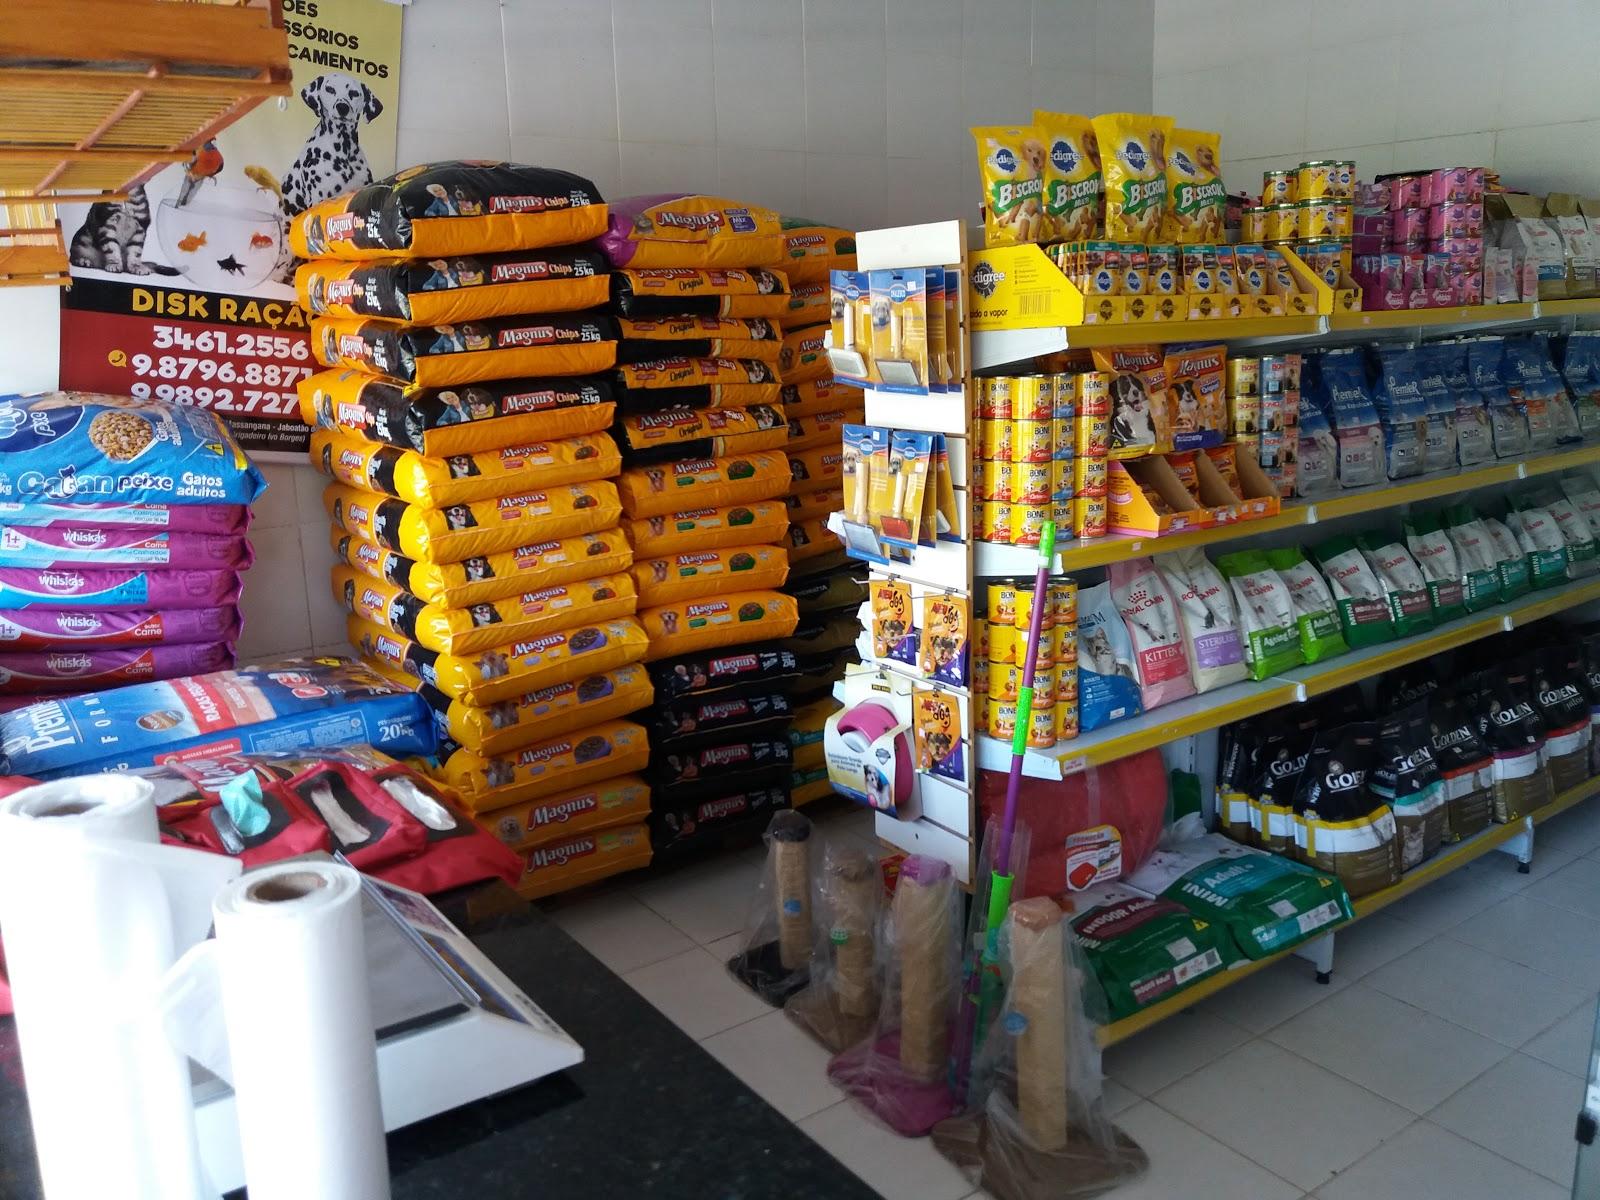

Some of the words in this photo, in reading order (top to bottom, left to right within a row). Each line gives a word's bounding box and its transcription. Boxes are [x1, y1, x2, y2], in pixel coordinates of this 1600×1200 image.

[288, 44, 388, 79] CAMENTOS
[490, 197, 542, 213] Magnus
[544, 196, 569, 208] Chips
[570, 198, 590, 208] 25kg
[327, 216, 352, 240] Magnus
[657, 212, 719, 229] Magnus
[789, 234, 824, 248] Magnus
[492, 263, 546, 281] Magnus
[549, 263, 573, 275] Chips
[574, 266, 595, 277] 25kg
[328, 281, 352, 305] Magnus
[679, 277, 704, 292] Original
[132, 288, 209, 319] DISK
[219, 297, 311, 330] RAÇÃ
[152, 325, 309, 361] 3461.2556
[498, 328, 553, 347] Magnus
[556, 329, 580, 340] Chips
[581, 332, 600, 343] 25kg
[340, 335, 364, 360] Magnus
[1113, 352, 1158, 372] Magnus
[1174, 357, 1219, 378] Magnus
[991, 383, 1010, 392] BONE
[503, 394, 554, 414] Magnus
[556, 393, 580, 403] Chips
[339, 403, 366, 428] Magnus
[639, 410, 695, 430] Magnus
[229, 420, 271, 431] assangana
[277, 423, 309, 433] Jaboatão
[679, 422, 703, 438] Original
[233, 432, 266, 440] rigadeiro
[501, 444, 547, 459] Magnus
[674, 459, 716, 475] Magnus
[117, 472, 174, 493] peixe
[182, 471, 223, 487] Gatos
[176, 485, 226, 498] adultos
[497, 493, 546, 510] Magnus
[1027, 510, 1045, 519] BONE
[4, 533, 21, 545] 1+
[63, 531, 106, 544] whiskas
[515, 541, 561, 559] Magnus
[678, 551, 719, 567] Magnus
[39, 574, 84, 586] whiskas
[521, 586, 567, 605] Magnus
[687, 601, 728, 617] Magnus
[57, 616, 102, 629] whiskas
[134, 627, 162, 636] Carne
[377, 636, 401, 659] Magnus
[512, 634, 565, 658] Magnus
[47, 657, 93, 669] whiskas
[125, 665, 153, 675] Carne
[710, 655, 757, 676] Magnus
[522, 681, 574, 707] Magnus
[699, 701, 746, 721] Magnus
[519, 742, 571, 766] Magnus
[701, 746, 749, 767] Magnus
[528, 795, 596, 830] Magnus
[527, 837, 595, 873] Magnus
[1182, 882, 1229, 907] MINI
[1082, 908, 1130, 933] INDOOR
